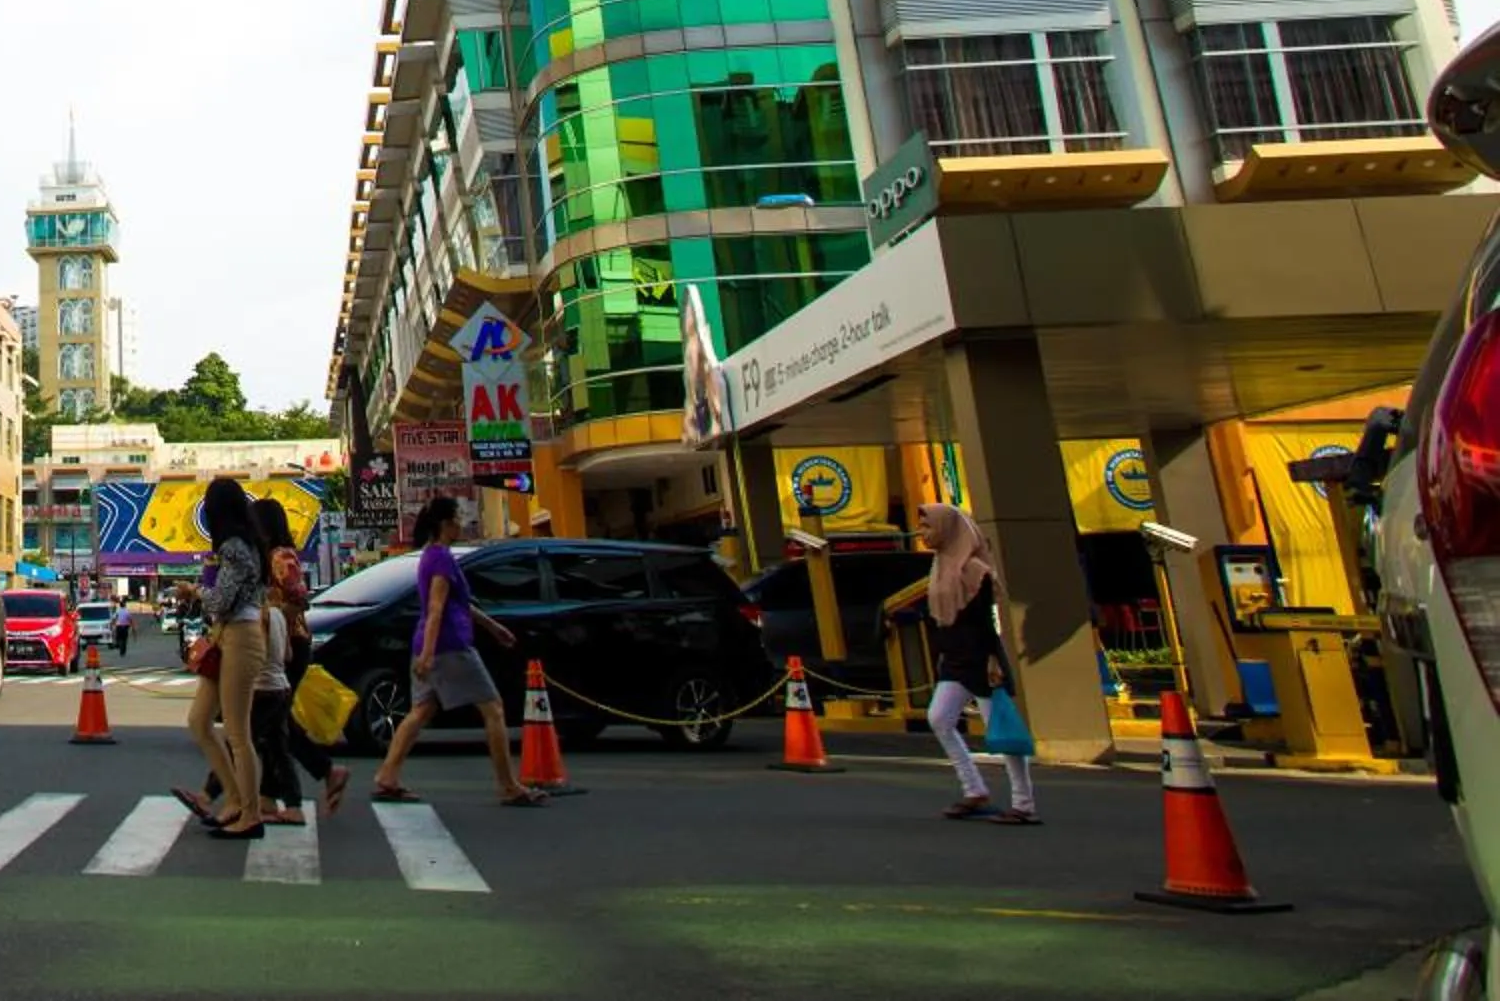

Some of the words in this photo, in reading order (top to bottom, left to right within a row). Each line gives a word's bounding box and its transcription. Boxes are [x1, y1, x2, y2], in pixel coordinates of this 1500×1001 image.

[868, 167, 920, 219] oppo
[741, 357, 761, 413] F9
[839, 318, 871, 350] 2-hour
[871, 301, 892, 334] talk
[471, 383, 523, 422] AK
